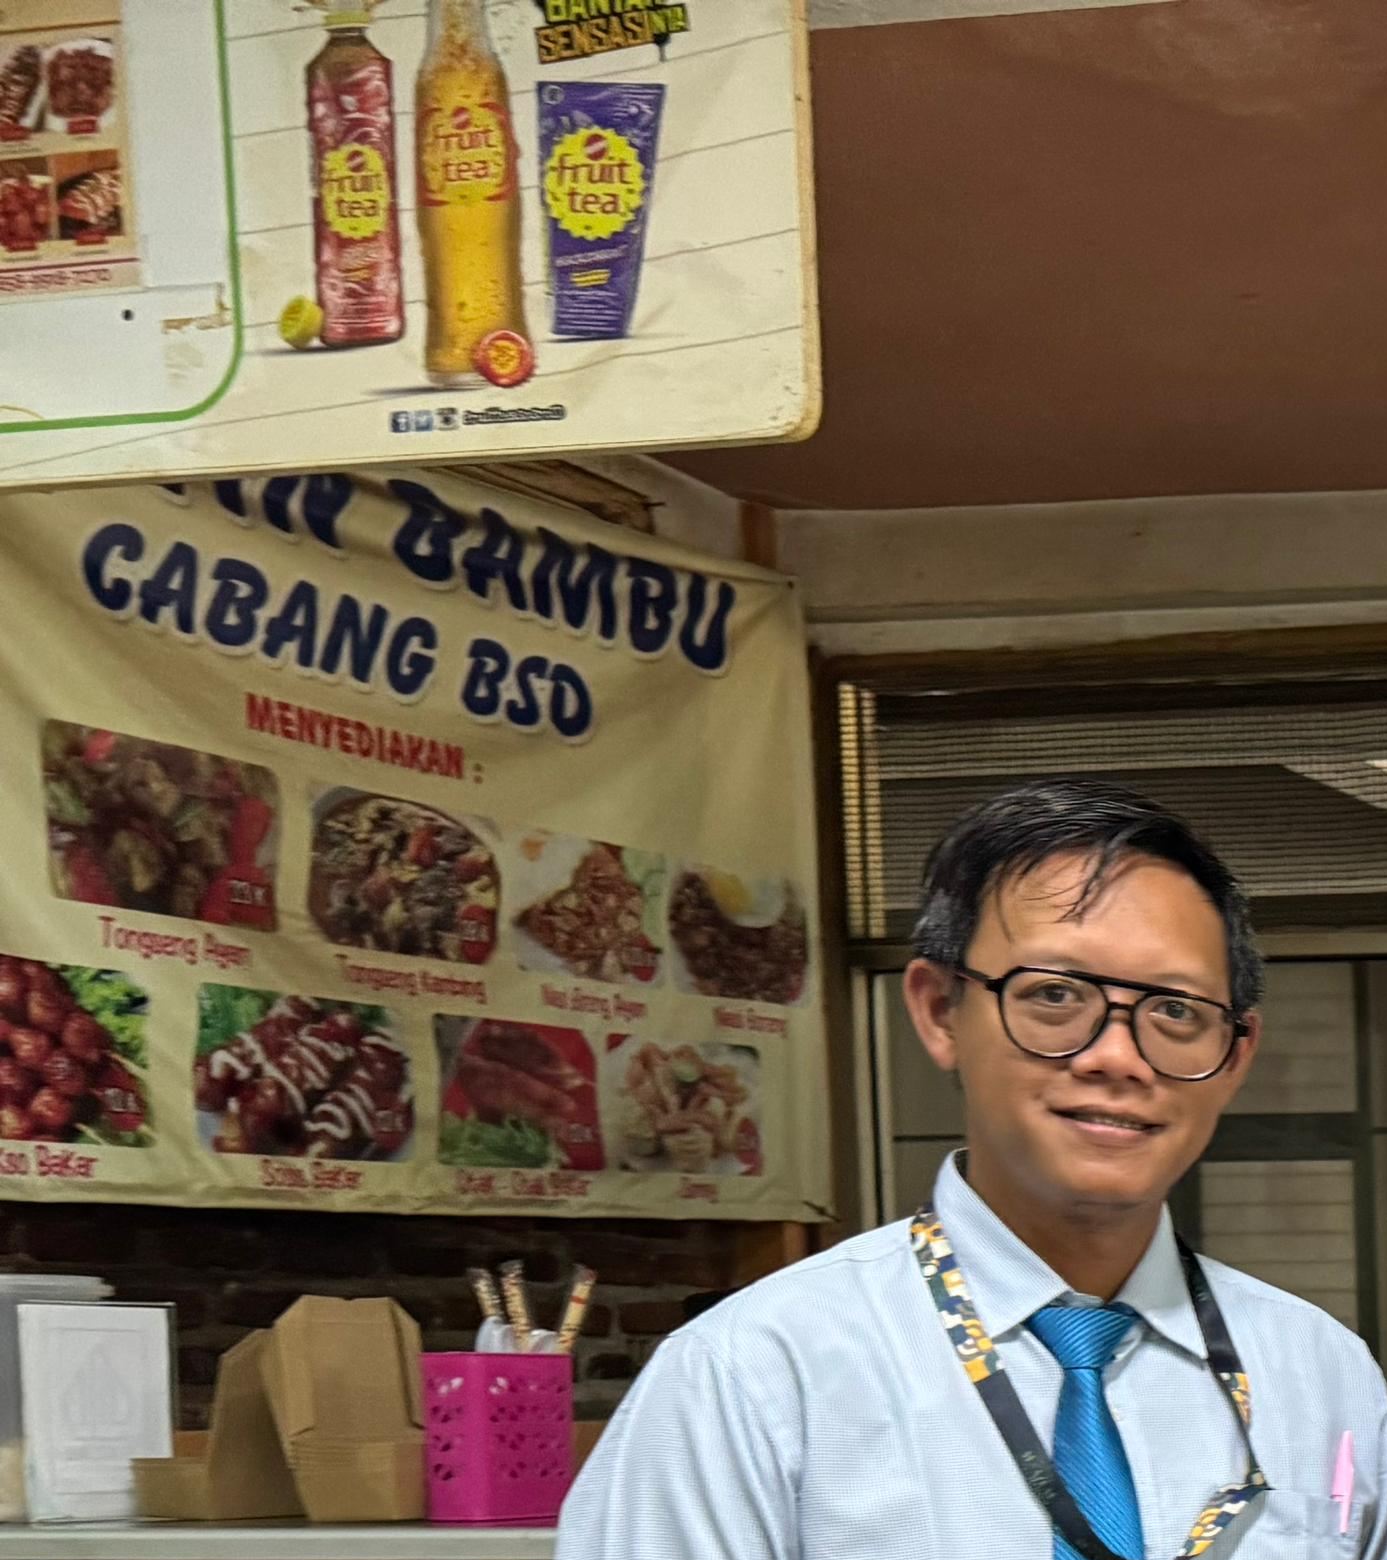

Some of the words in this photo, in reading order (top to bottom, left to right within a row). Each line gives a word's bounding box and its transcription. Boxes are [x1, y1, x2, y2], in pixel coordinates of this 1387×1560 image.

[434, 127, 494, 150] fruit
[442, 159, 490, 182] tea
[557, 152, 632, 186] fruit
[336, 198, 378, 218] tea
[567, 190, 620, 215] tea
[388, 476, 736, 672] BAMBU
[81, 522, 438, 697] CABANG
[461, 637, 594, 738] BSD
[245, 690, 464, 781] MENYEDIAKAN
